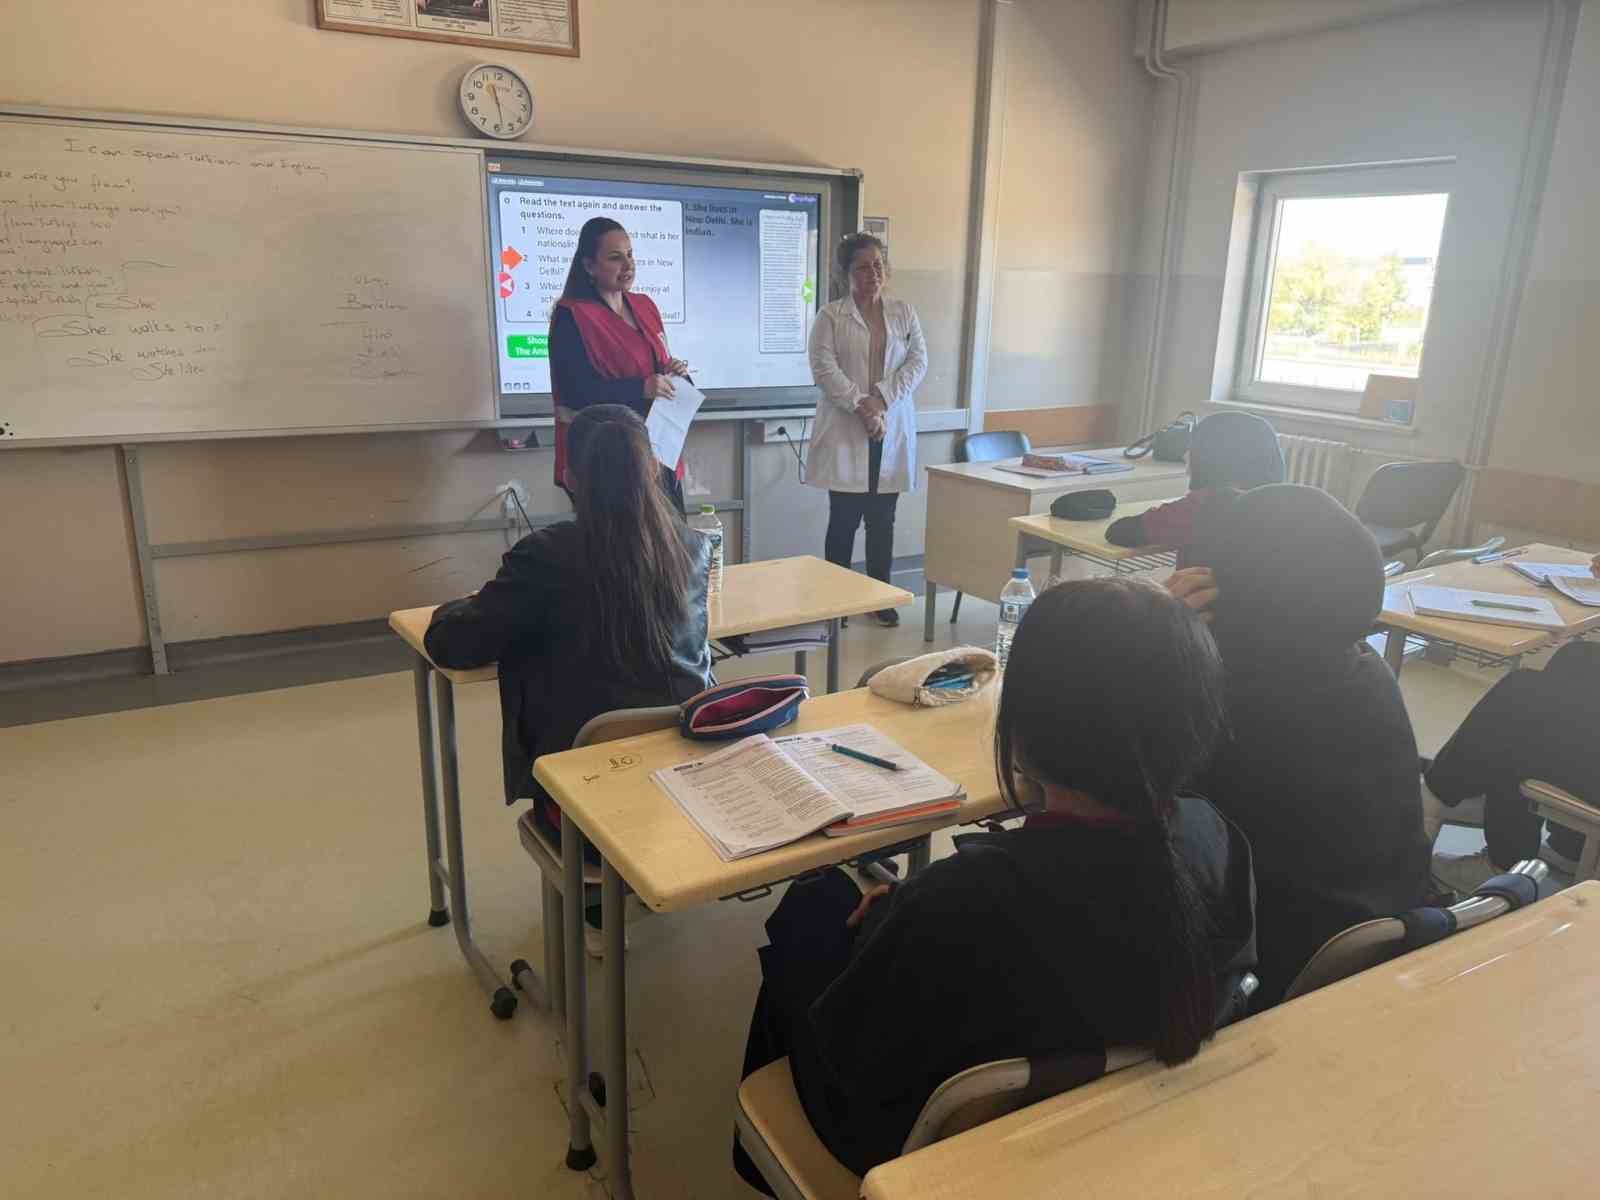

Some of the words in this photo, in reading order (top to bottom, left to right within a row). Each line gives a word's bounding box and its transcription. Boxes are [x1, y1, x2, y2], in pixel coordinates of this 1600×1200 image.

[473, 79, 483, 89] 10
[520, 196, 542, 206] Read
[544, 198, 558, 207] the
[560, 199, 576, 209] text
[577, 202, 601, 212] again
[602, 202, 618, 210] and
[619, 203, 649, 212] answer
[650, 205, 663, 213] the
[520, 209, 566, 221] questions.
[536, 225, 564, 236] Where
[640, 231, 659, 240] what
[660, 232, 666, 240] is
[538, 254, 560, 264] What
